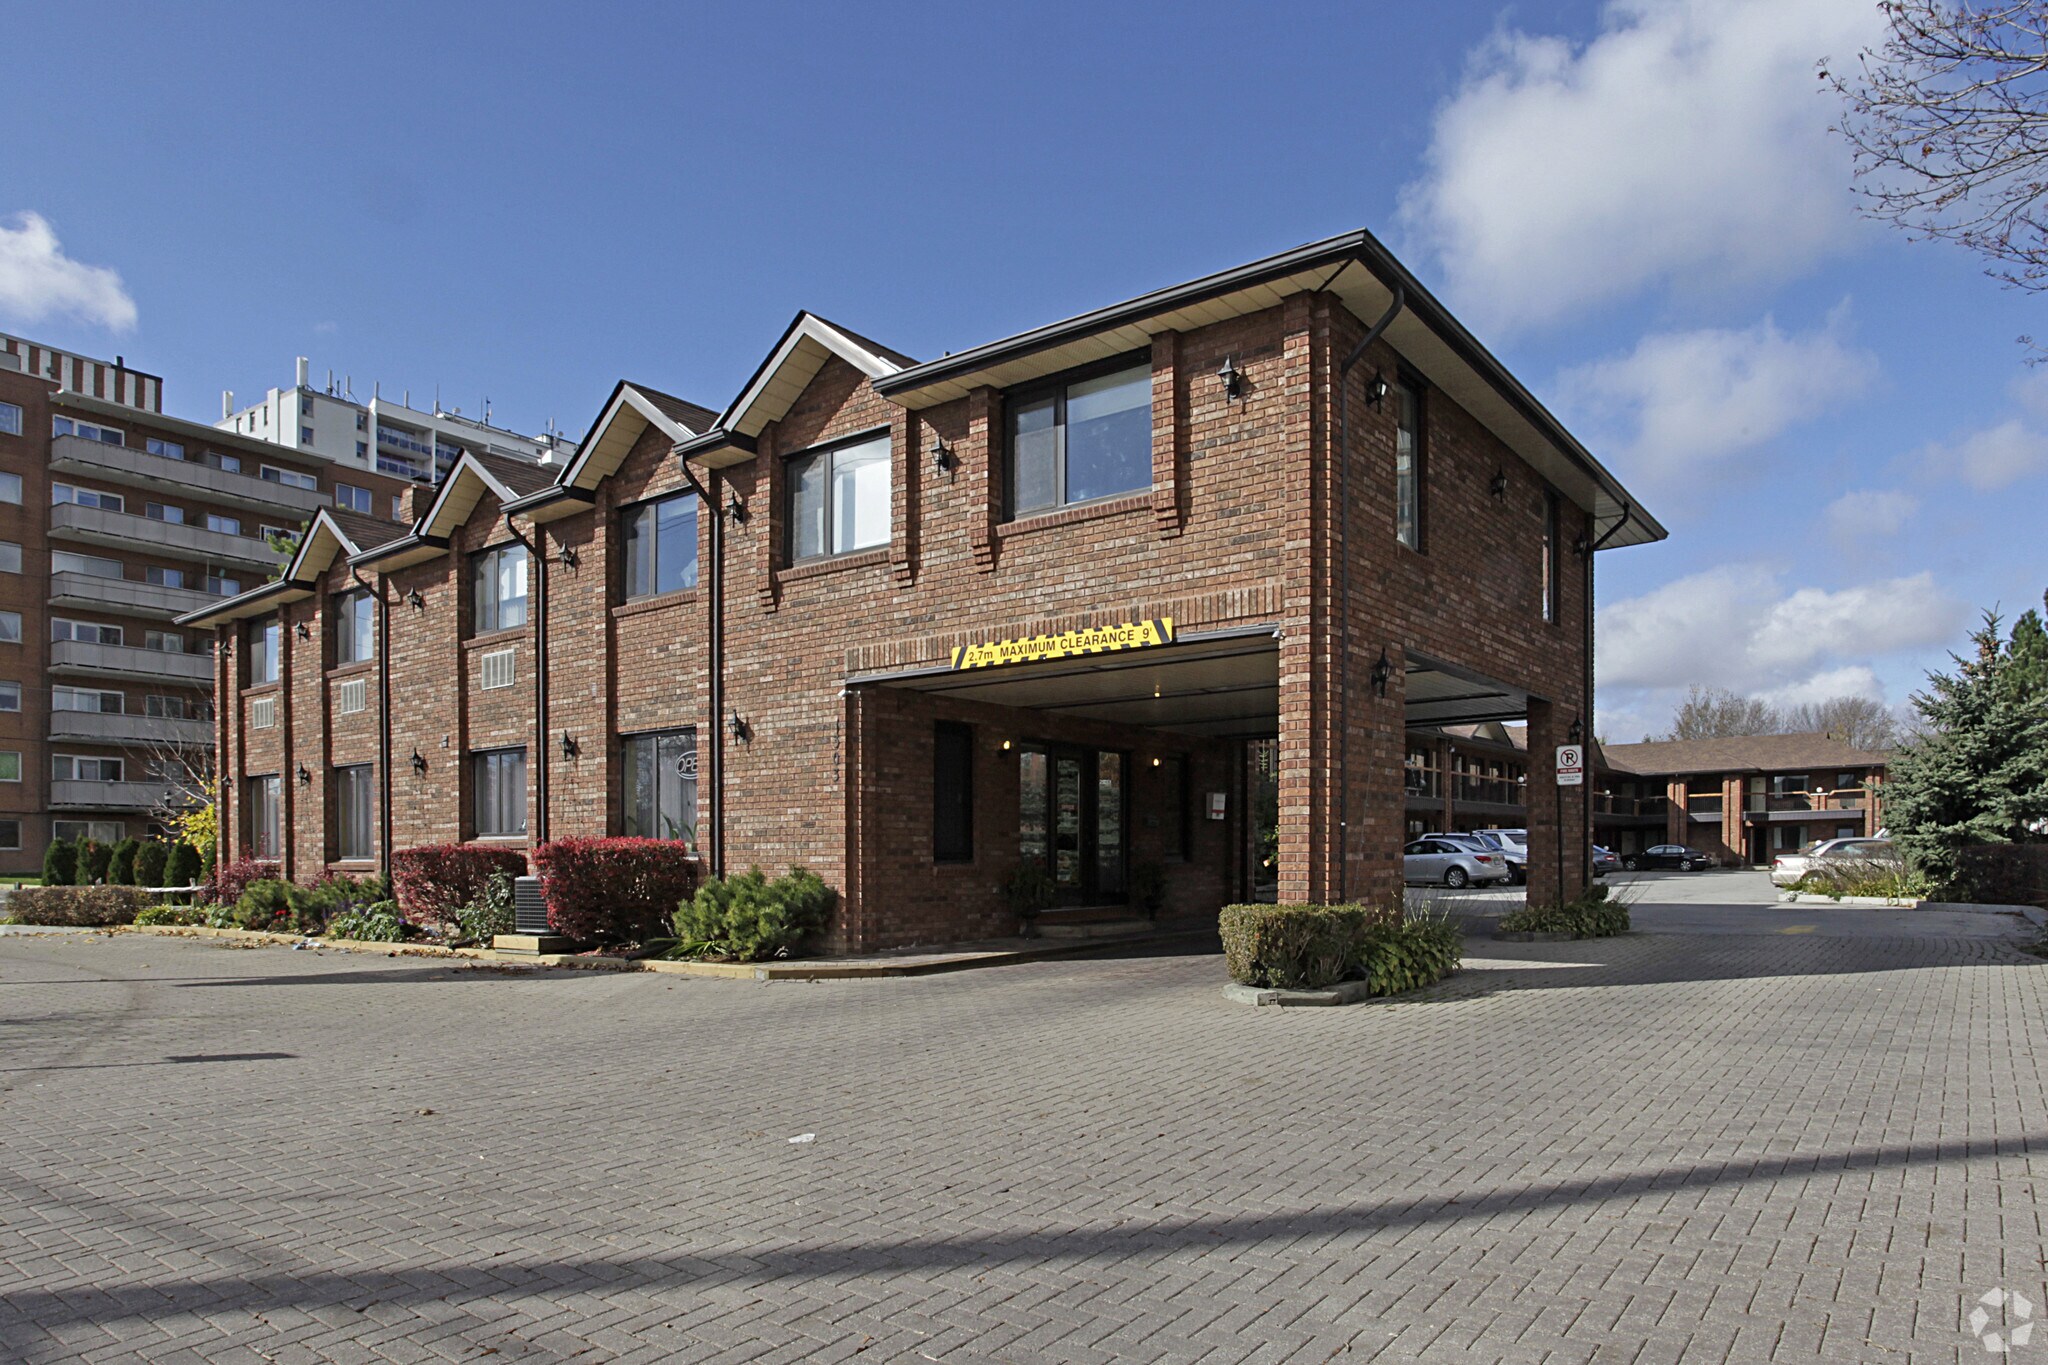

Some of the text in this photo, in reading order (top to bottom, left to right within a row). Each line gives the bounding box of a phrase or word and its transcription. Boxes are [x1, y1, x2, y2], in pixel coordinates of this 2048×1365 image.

[968, 650, 994, 662] 2.7m
[1000, 640, 1056, 658] MAXIMUM
[1060, 629, 1135, 650] CLEARANCE
[676, 757, 698, 773] OPE
